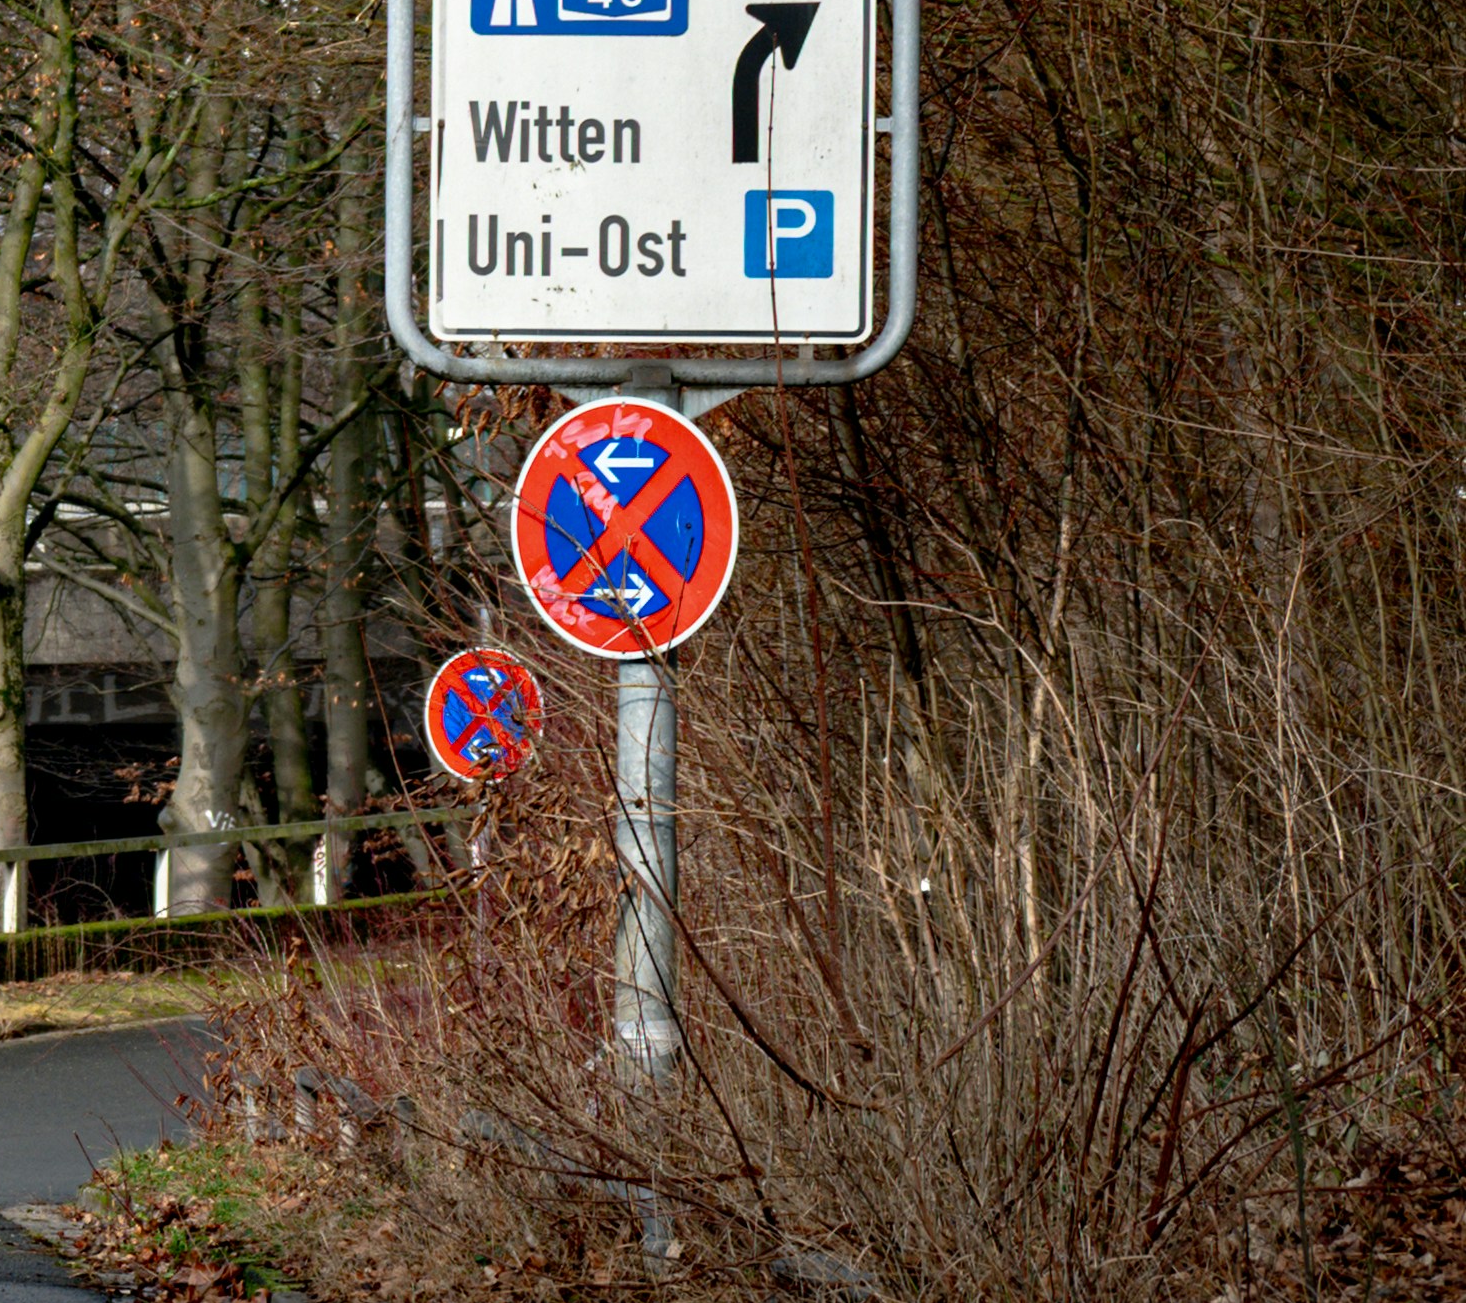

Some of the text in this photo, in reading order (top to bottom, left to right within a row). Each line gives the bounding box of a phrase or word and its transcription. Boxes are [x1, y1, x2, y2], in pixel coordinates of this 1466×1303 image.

[469, 99, 642, 164] Witten
[467, 214, 687, 278] Uni-Ost
[766, 198, 817, 271] P
